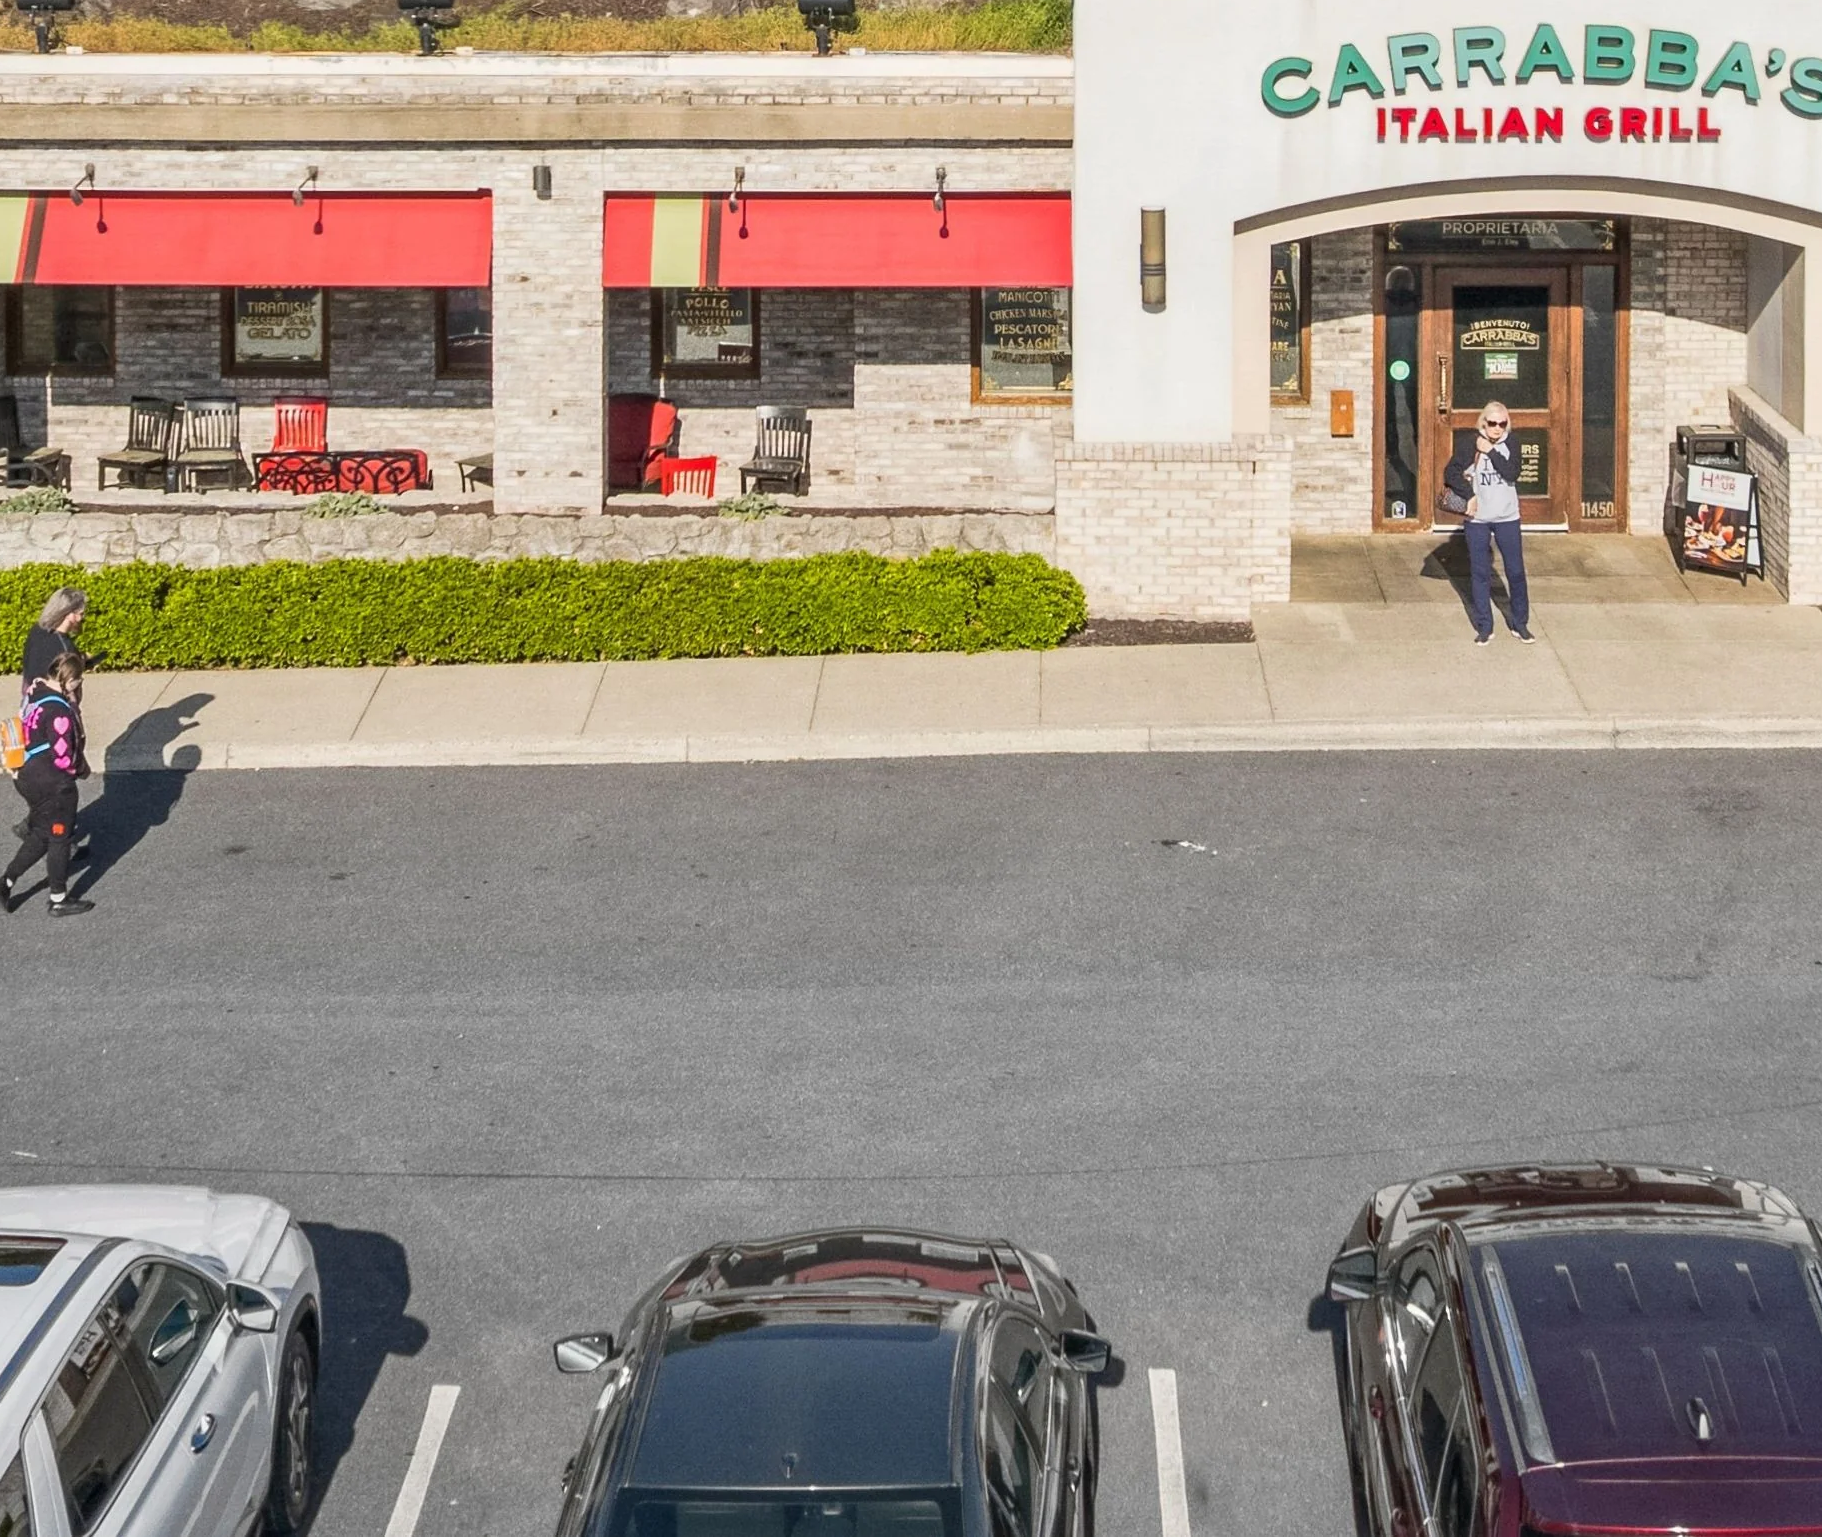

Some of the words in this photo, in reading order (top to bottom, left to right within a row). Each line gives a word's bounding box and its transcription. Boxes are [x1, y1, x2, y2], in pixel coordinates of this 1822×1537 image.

[1376, 106, 1564, 143] ITALIAN
[1583, 106, 1723, 143] GRILL
[1442, 221, 1559, 235] PROPRIETARIA
[247, 327, 312, 340] GELATO
[1581, 500, 1614, 519] 11450
